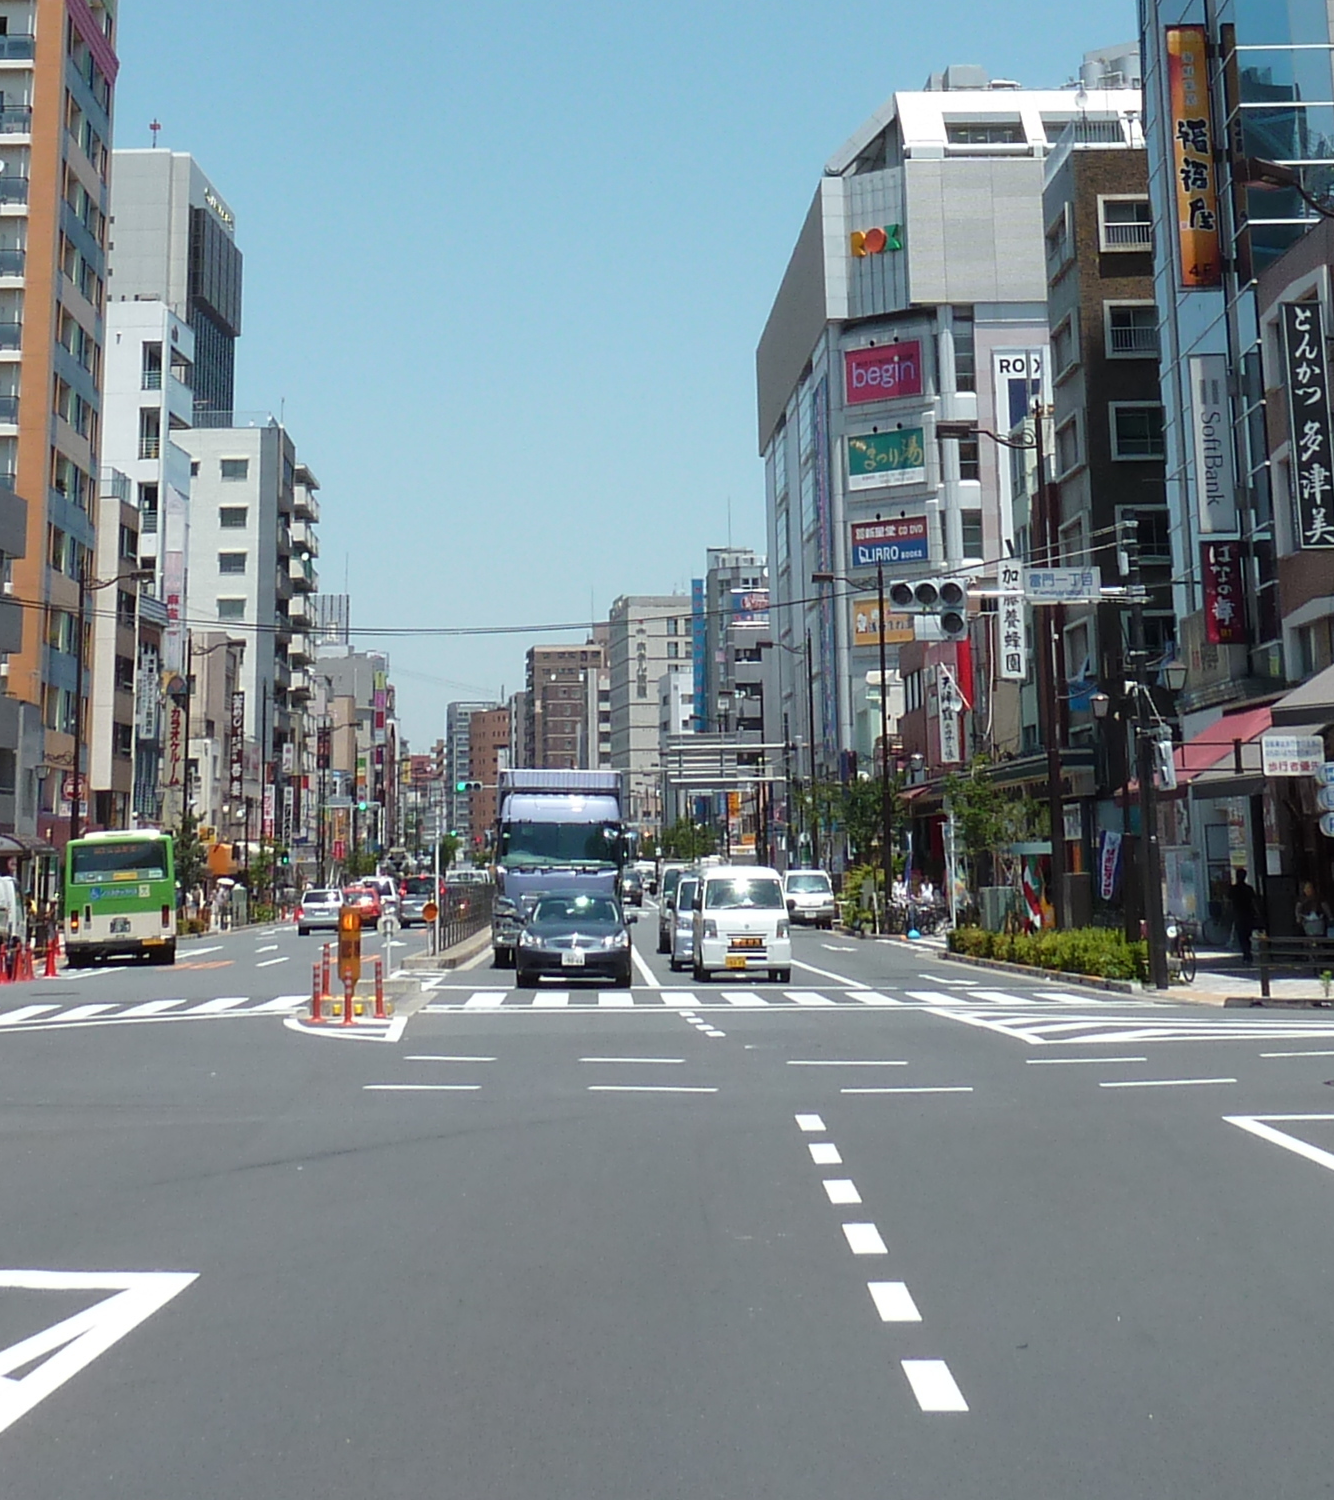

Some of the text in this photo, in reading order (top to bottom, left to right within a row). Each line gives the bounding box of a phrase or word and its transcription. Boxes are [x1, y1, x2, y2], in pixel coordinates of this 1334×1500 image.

[851, 223, 903, 258] ROX
[852, 355, 914, 390] begin
[1293, 306, 1322, 406] とんかつ
[1200, 411, 1225, 506] SoftBank
[1029, 572, 1093, 588] 雷門一丁目
[1210, 545, 1235, 625] はなの舞
[169, 707, 181, 787] カラオケルーム
